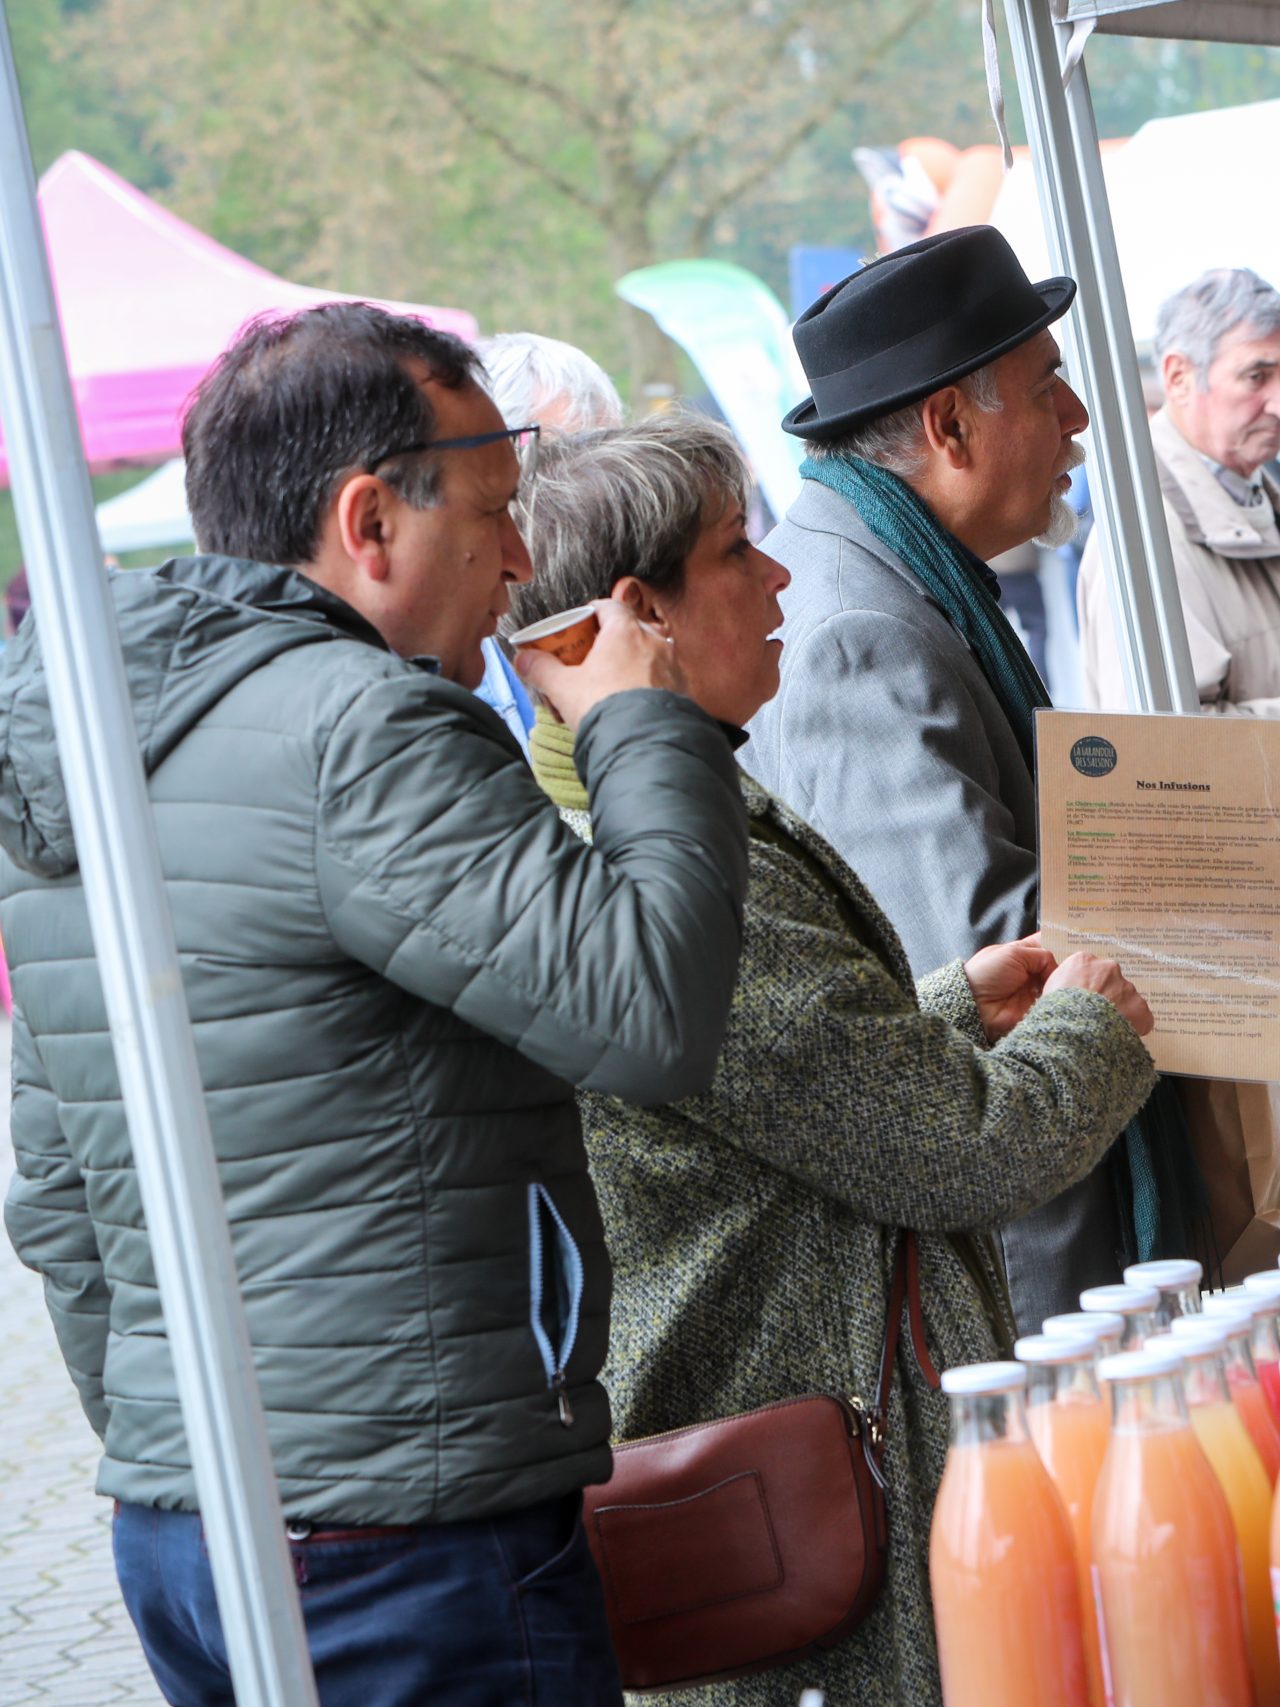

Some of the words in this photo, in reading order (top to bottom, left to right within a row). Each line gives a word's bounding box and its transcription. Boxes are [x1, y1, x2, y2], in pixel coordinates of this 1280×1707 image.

[1073, 747, 1081, 756] LA
[1075, 757, 1087, 767] DES
[1087, 757, 1114, 768] SAISONS
[1136, 781, 1156, 789] Nos
[1160, 781, 1211, 790] Infusions
